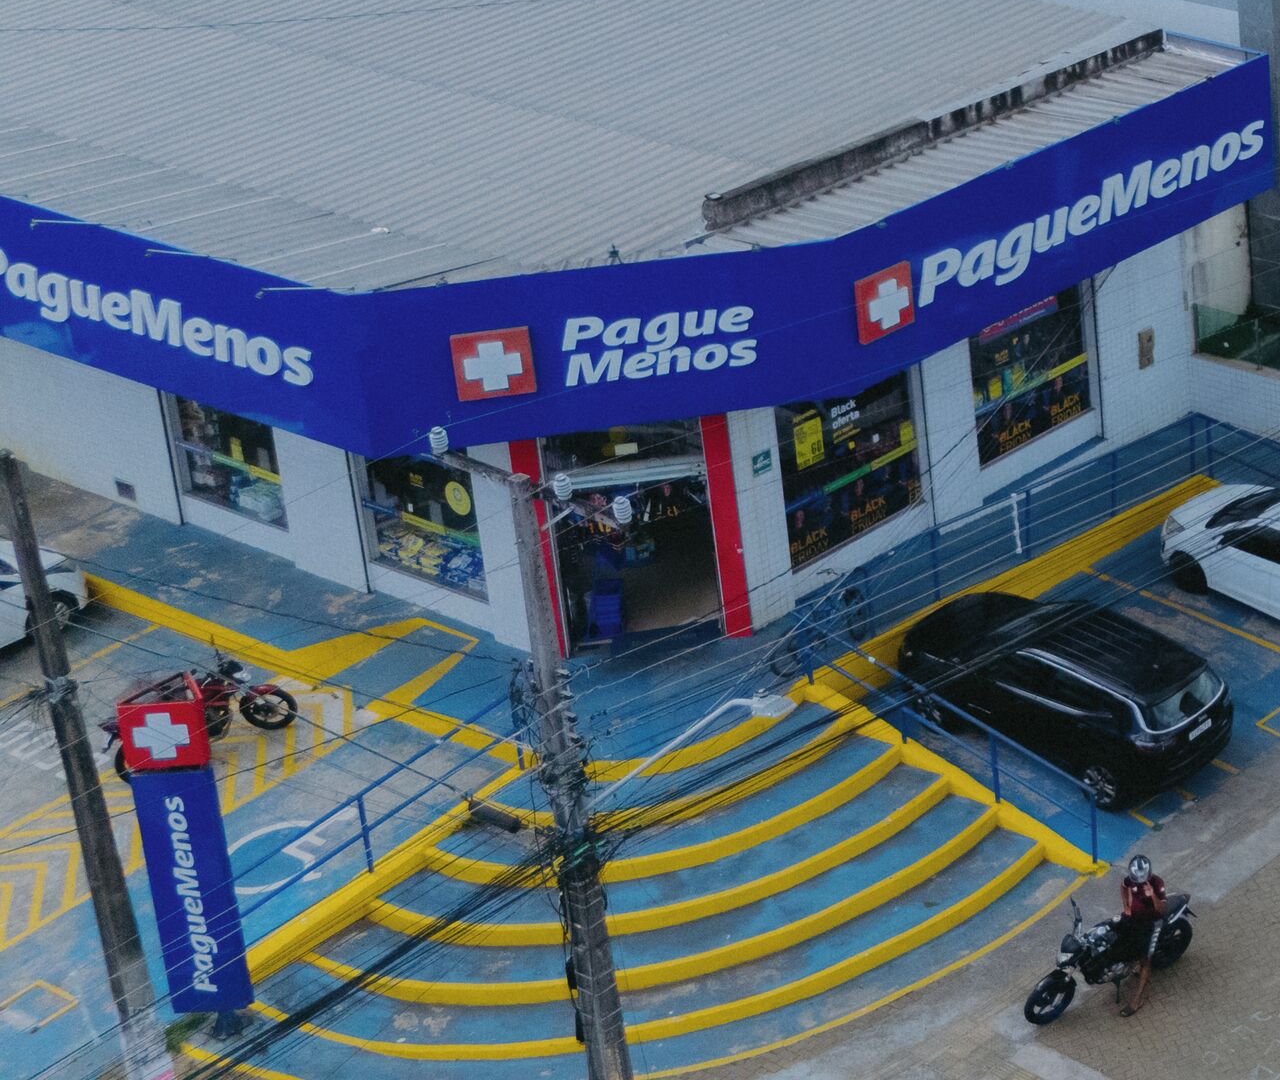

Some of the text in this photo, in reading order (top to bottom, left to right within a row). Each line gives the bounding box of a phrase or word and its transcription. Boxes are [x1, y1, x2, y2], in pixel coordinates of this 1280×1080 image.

[918, 120, 1265, 308] PagueMenos
[0, 246, 314, 386] agueMenos
[561, 305, 755, 353] Pague
[565, 339, 758, 387] Menos
[831, 399, 857, 418] Black
[832, 410, 860, 429] oferta
[849, 495, 886, 521] BLACK
[790, 526, 828, 554] BLACK
[165, 795, 218, 993] PagueMenos
